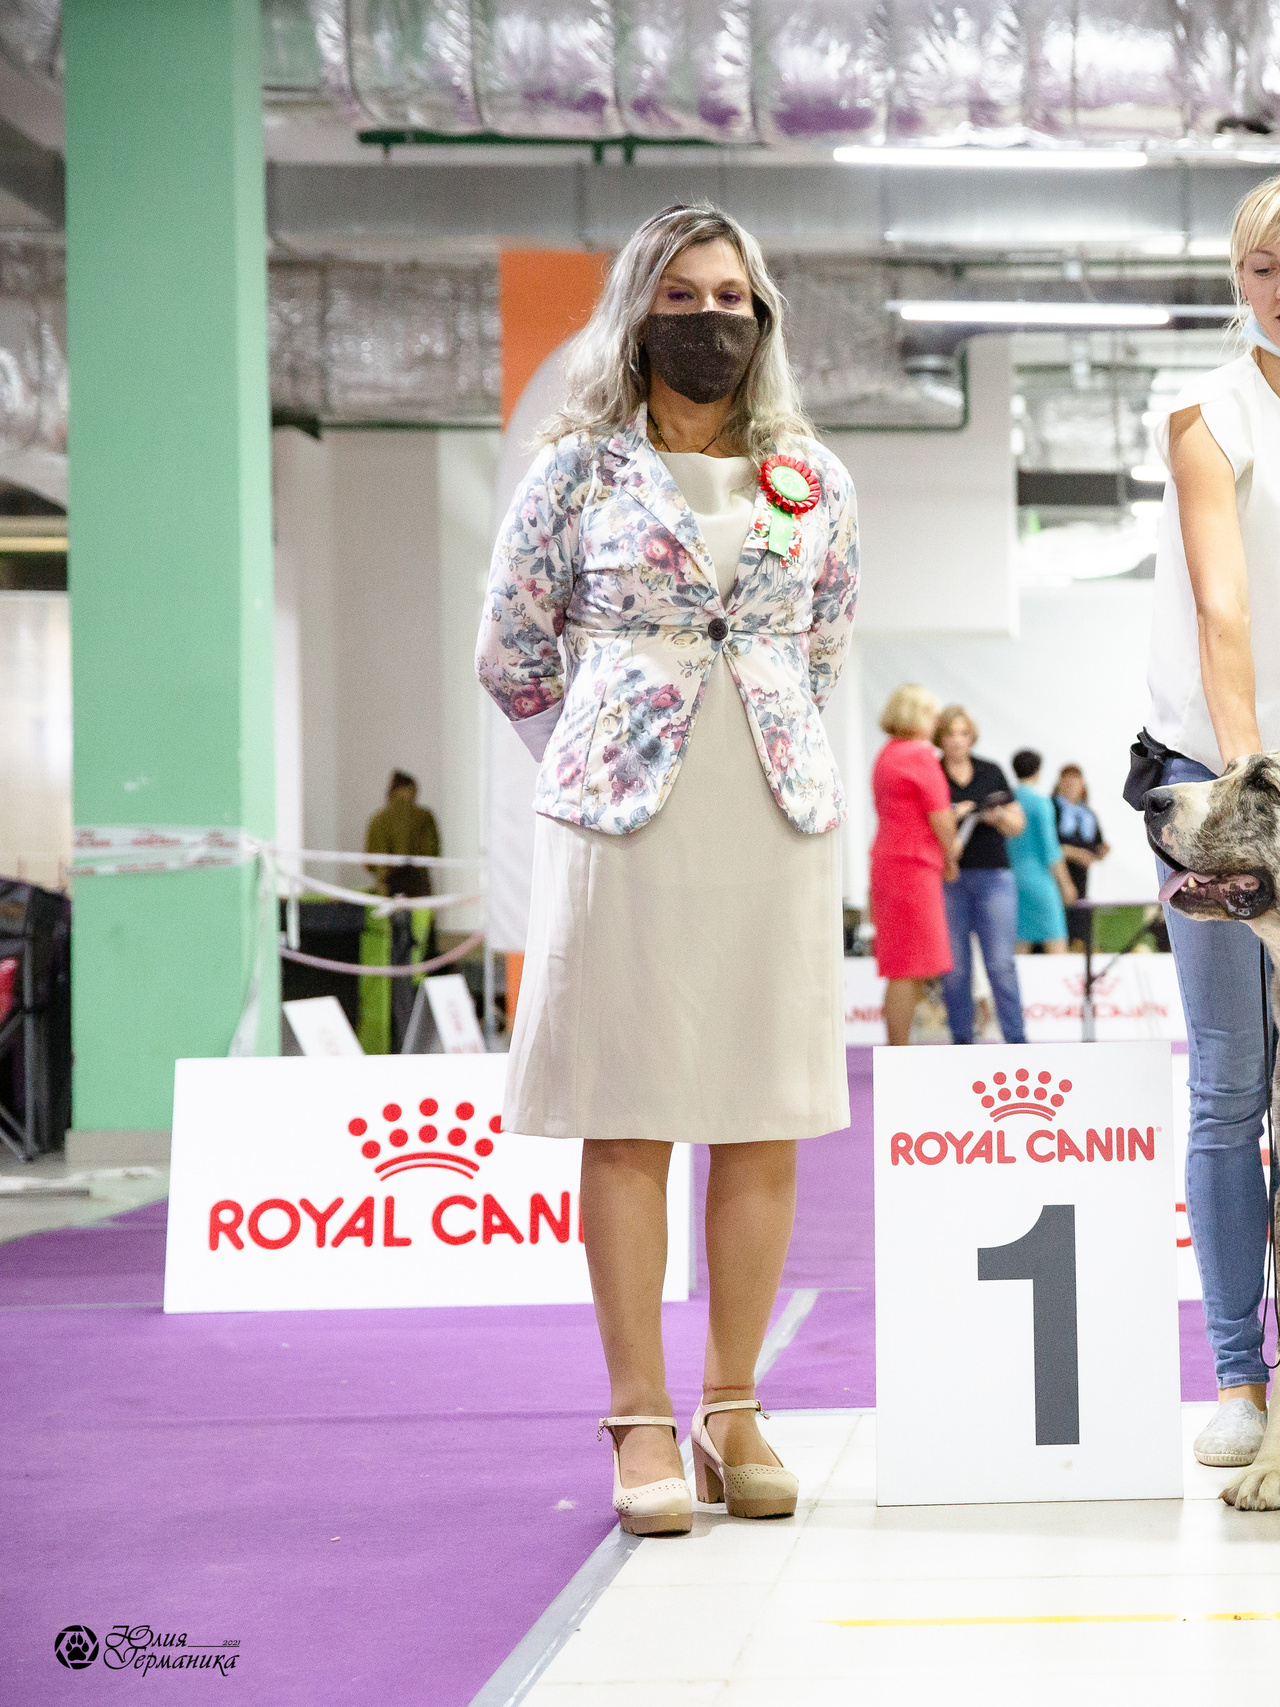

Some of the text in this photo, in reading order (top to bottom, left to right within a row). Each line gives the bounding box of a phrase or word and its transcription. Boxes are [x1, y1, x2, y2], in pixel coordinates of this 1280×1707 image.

[891, 1127, 1154, 1166] ROYAL CANIN
[208, 1195, 412, 1251] ROYAL
[977, 1204, 1080, 1445] 1
